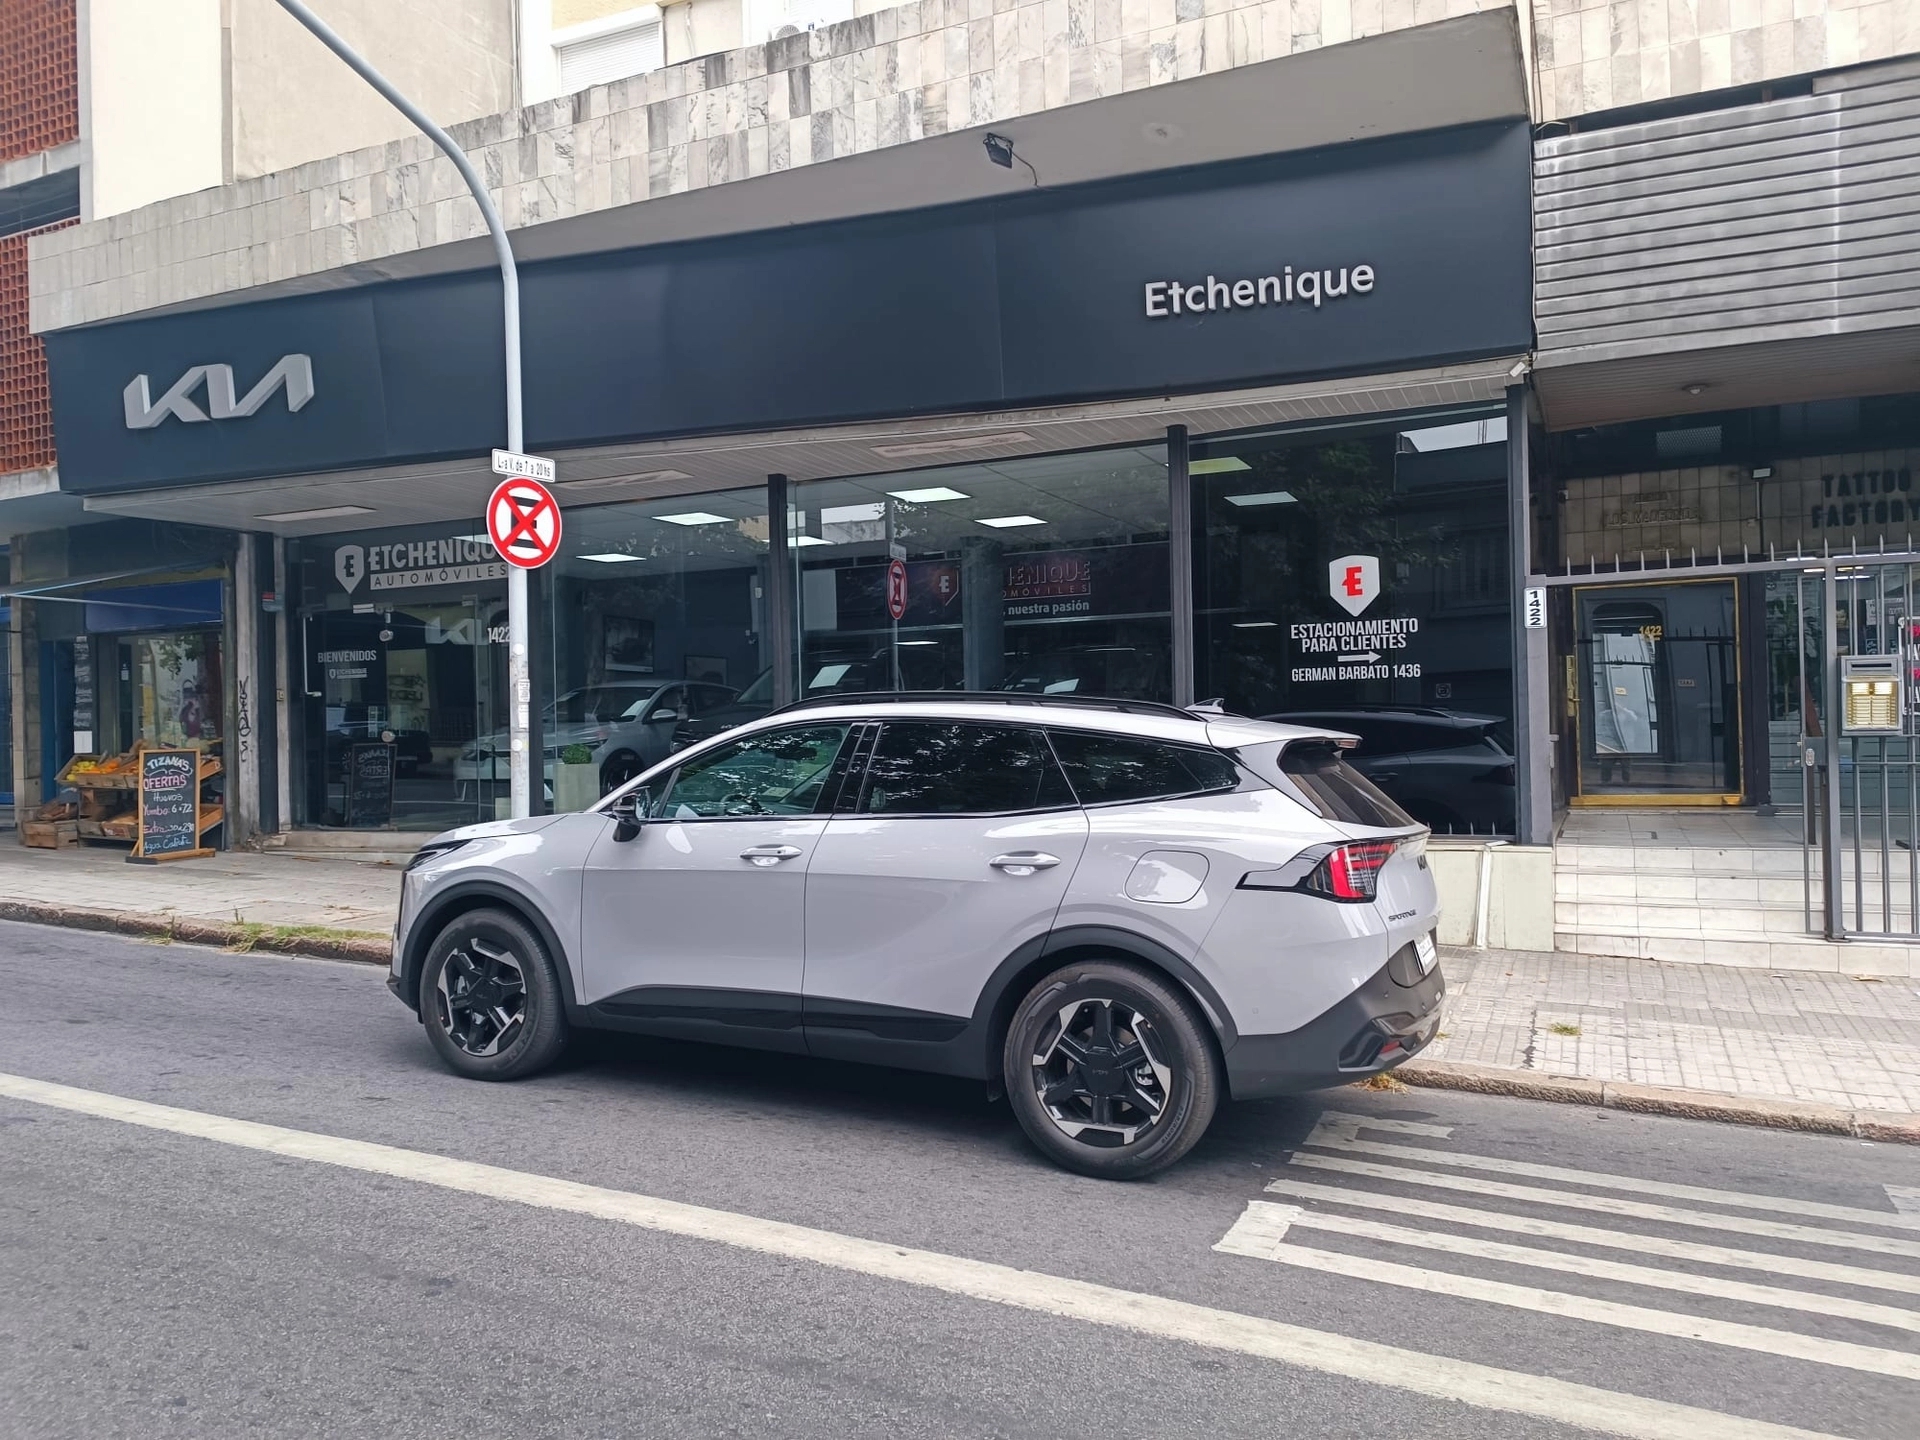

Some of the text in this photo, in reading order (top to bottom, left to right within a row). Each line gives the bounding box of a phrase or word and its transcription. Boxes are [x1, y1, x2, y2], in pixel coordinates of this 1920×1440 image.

[1145, 263, 1375, 317] Etchenique
[123, 353, 315, 429] KIA
[516, 459, 523, 472] de
[1821, 467, 1911, 498] TATTOO
[1811, 499, 1920, 529] FACTORY
[368, 538, 498, 571] ETCHENIQU
[374, 565, 507, 587] AUTOMÓVILES
[1008, 599, 1090, 616] nuestra pasión
[1529, 590, 1542, 626] 1422
[1290, 617, 1419, 640] ESTACIONAMIENTO
[1638, 625, 1663, 636] 1422
[1302, 633, 1407, 653] PARA CLIENTES
[317, 650, 377, 663] BIENVENIDOS
[1291, 663, 1421, 682] GERMAN BARBATO 1436
[143, 774, 187, 790] OFERTAS
[144, 841, 161, 855] Agua
